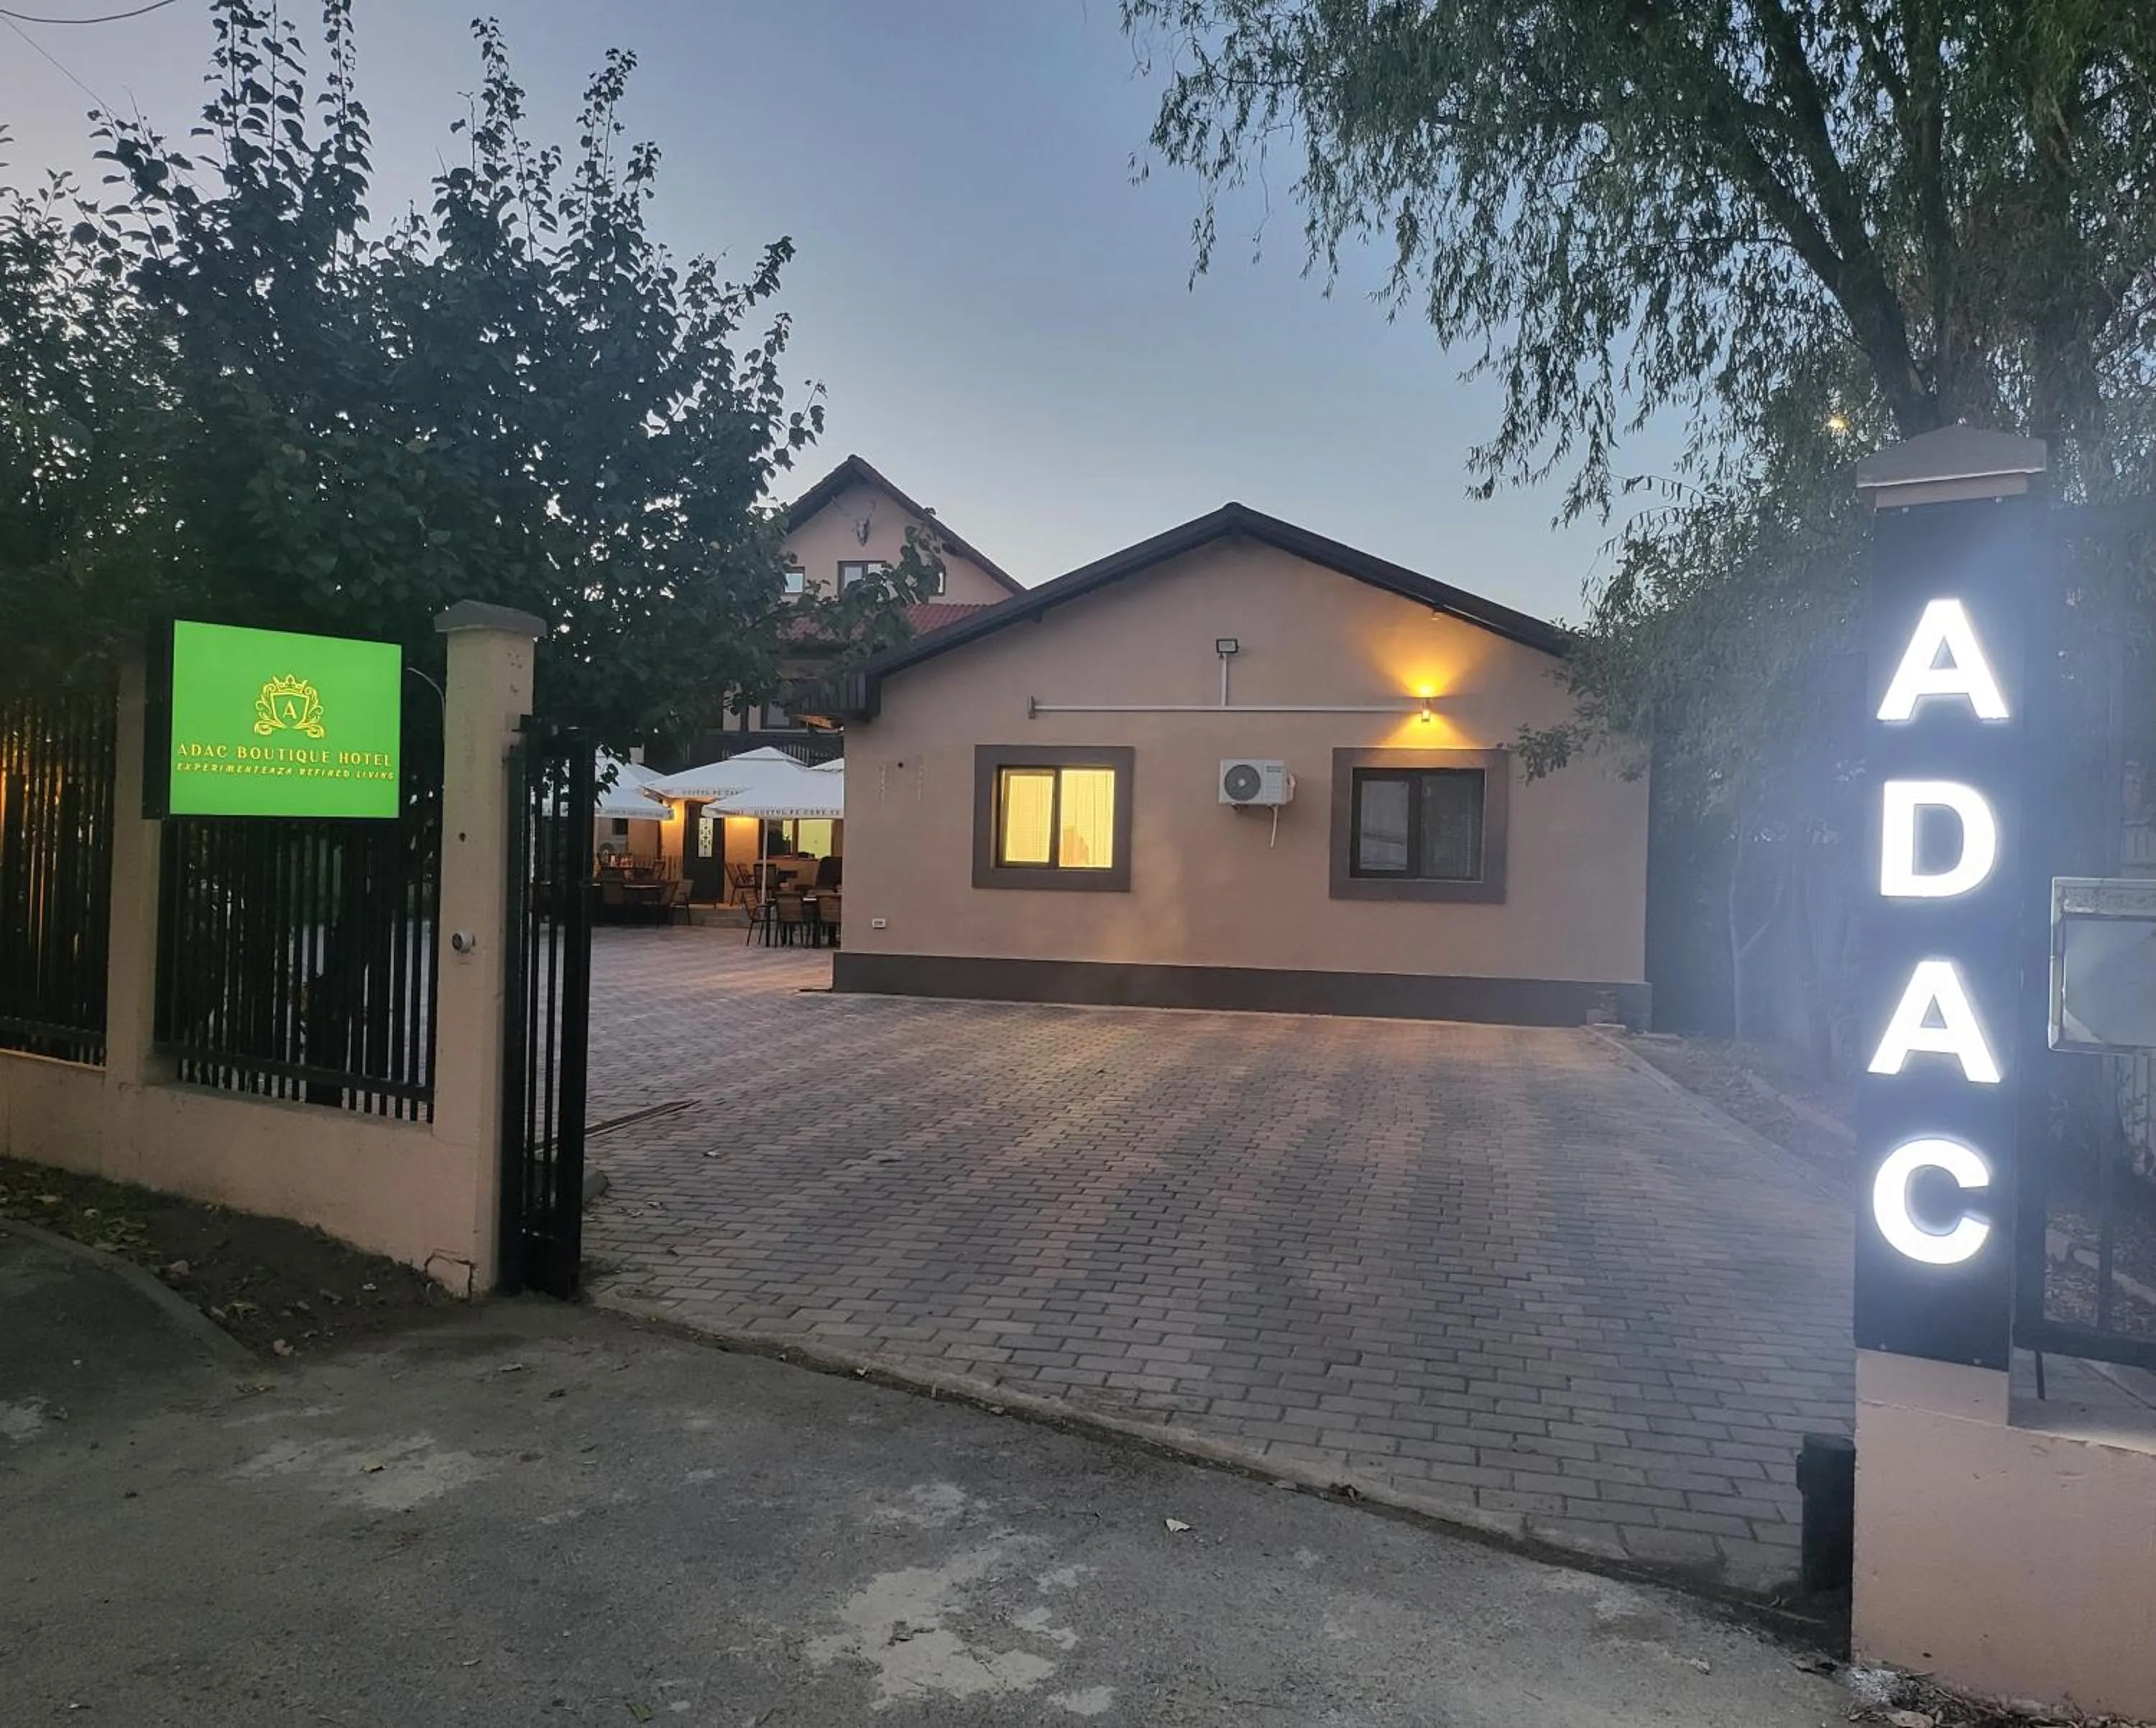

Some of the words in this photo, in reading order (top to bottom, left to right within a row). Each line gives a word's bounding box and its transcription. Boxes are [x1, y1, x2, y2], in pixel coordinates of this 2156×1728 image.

[282, 700, 298, 720] A
[178, 743, 227, 759] ADAC
[237, 747, 331, 764] BOUTIQUE
[338, 751, 392, 767] HOTEL
[298, 767, 351, 778] REFINED
[356, 771, 395, 781] LIVING
[1868, 598, 2010, 1265] ADAC
